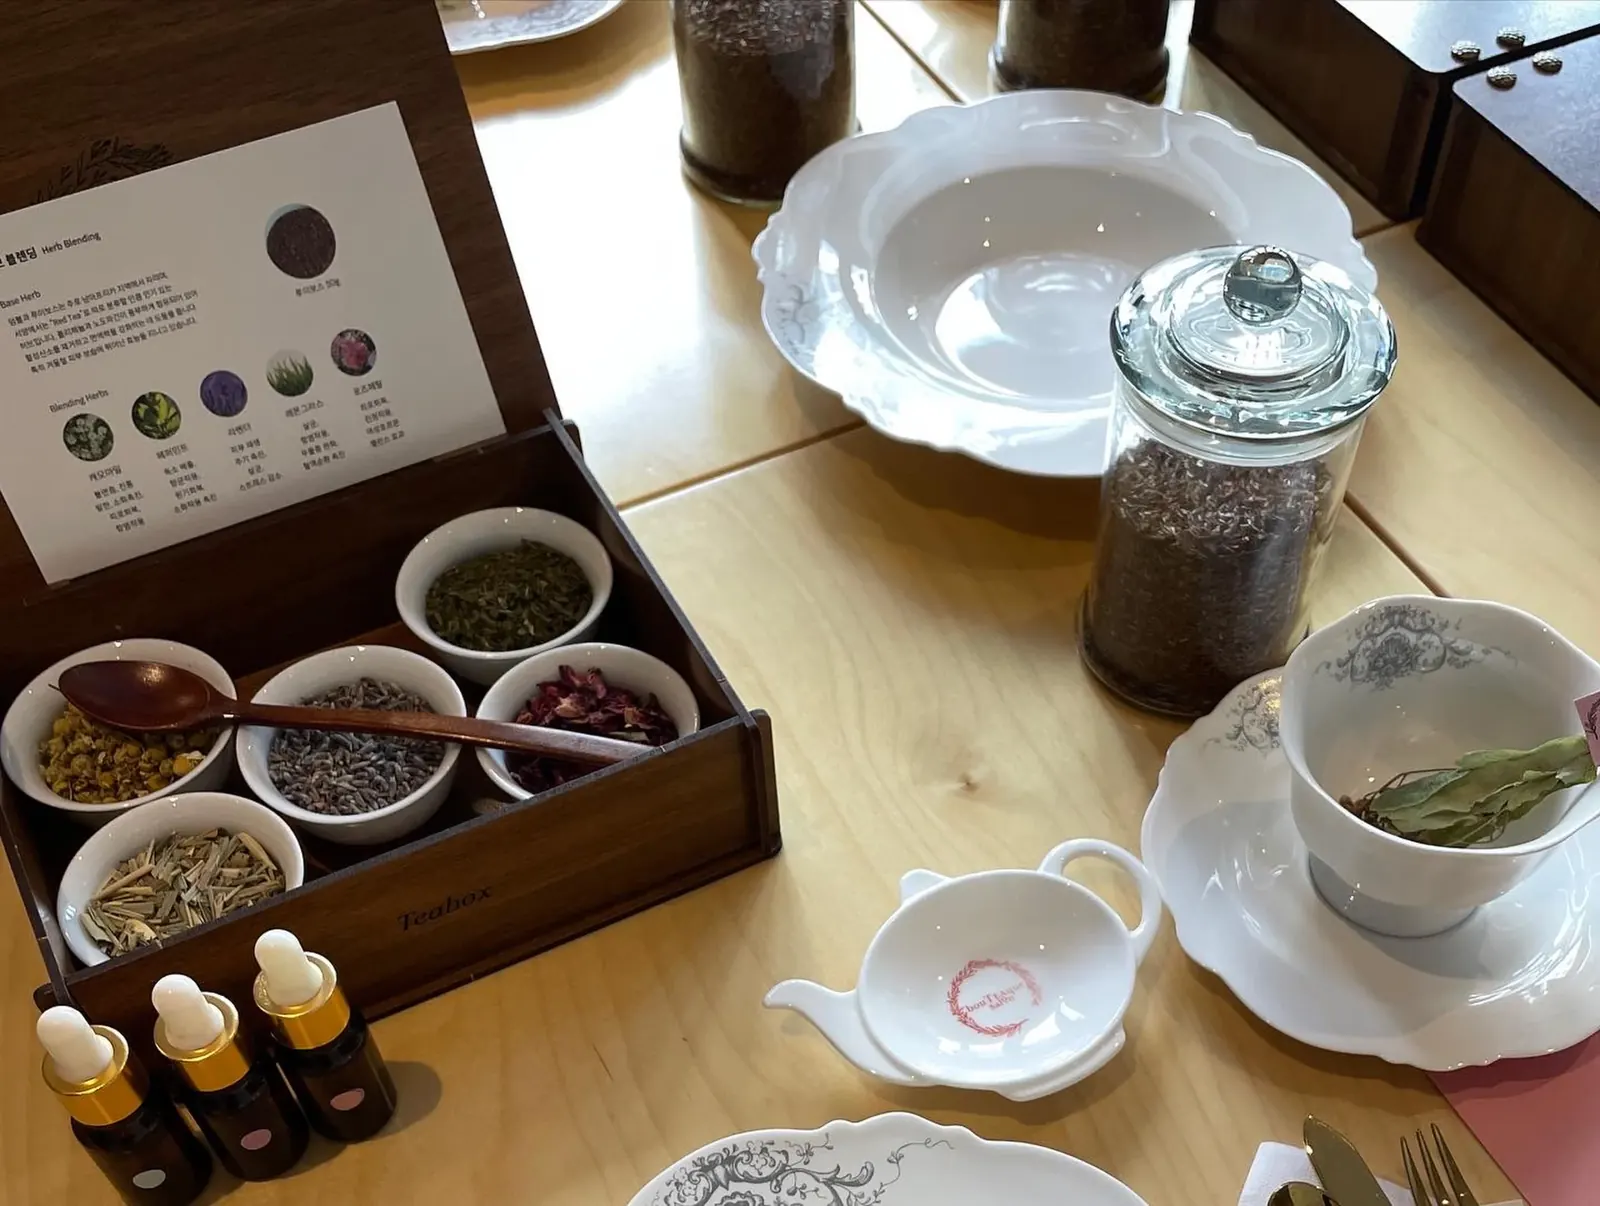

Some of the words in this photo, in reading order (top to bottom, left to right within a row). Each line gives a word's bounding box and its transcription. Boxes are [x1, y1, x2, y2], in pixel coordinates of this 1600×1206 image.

[5, 246, 38, 266] 블렌딩
[41, 240, 63, 255] Herb
[63, 232, 102, 248] Blending
[0, 298, 20, 309] Base
[19, 290, 41, 302] Herb
[67, 297, 81, 307] 주로
[81, 287, 117, 304] 남아프리카
[158, 285, 172, 294] 있는
[128, 303, 155, 317] 풍부하게
[49, 396, 86, 413] Blending
[84, 389, 109, 402] Herbs
[396, 885, 493, 932] Teabox
